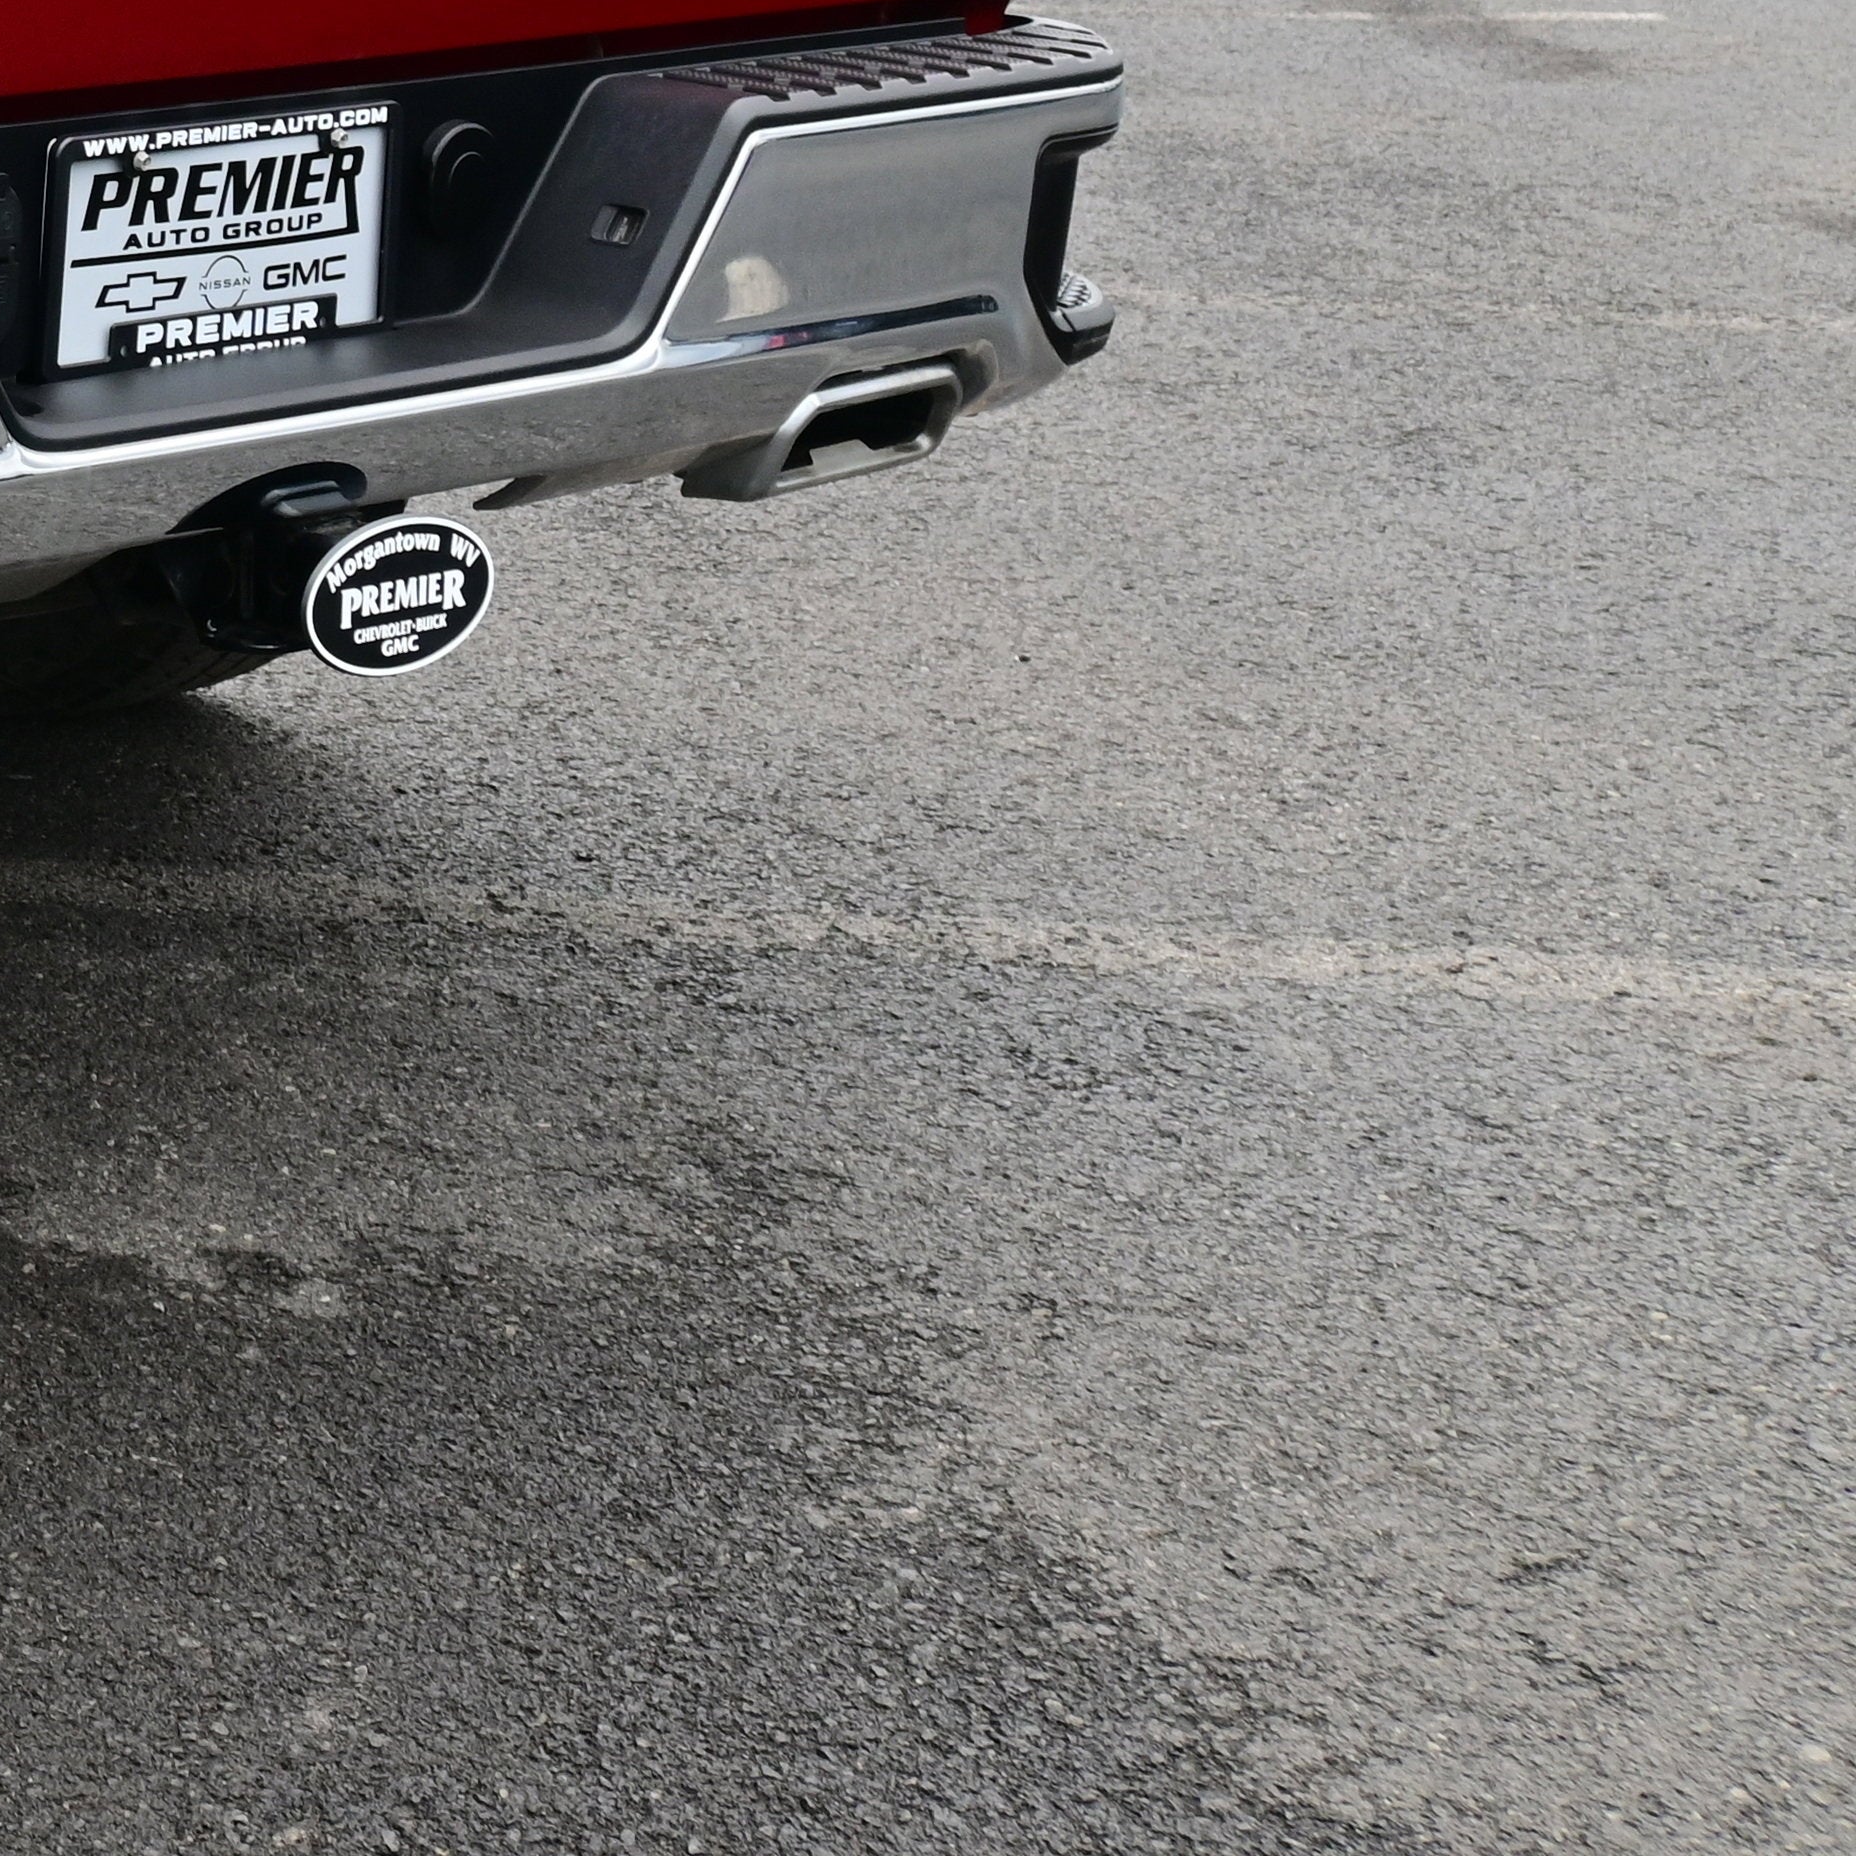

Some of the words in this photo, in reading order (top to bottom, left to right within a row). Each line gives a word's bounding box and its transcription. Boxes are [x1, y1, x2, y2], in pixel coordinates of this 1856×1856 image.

[83, 106, 388, 158] WWW.PREMIER-AUTO.COM
[81, 145, 365, 233] PREMIER
[123, 226, 210, 251] AUTO
[222, 212, 323, 240] GROUP
[199, 276, 251, 291] NISSAN
[263, 254, 347, 291] GMC
[136, 300, 319, 354] PREMIER
[325, 531, 441, 594] Morgantown
[450, 532, 481, 568] WV
[340, 569, 467, 631] PREMIER
[380, 634, 420, 658] GMC
